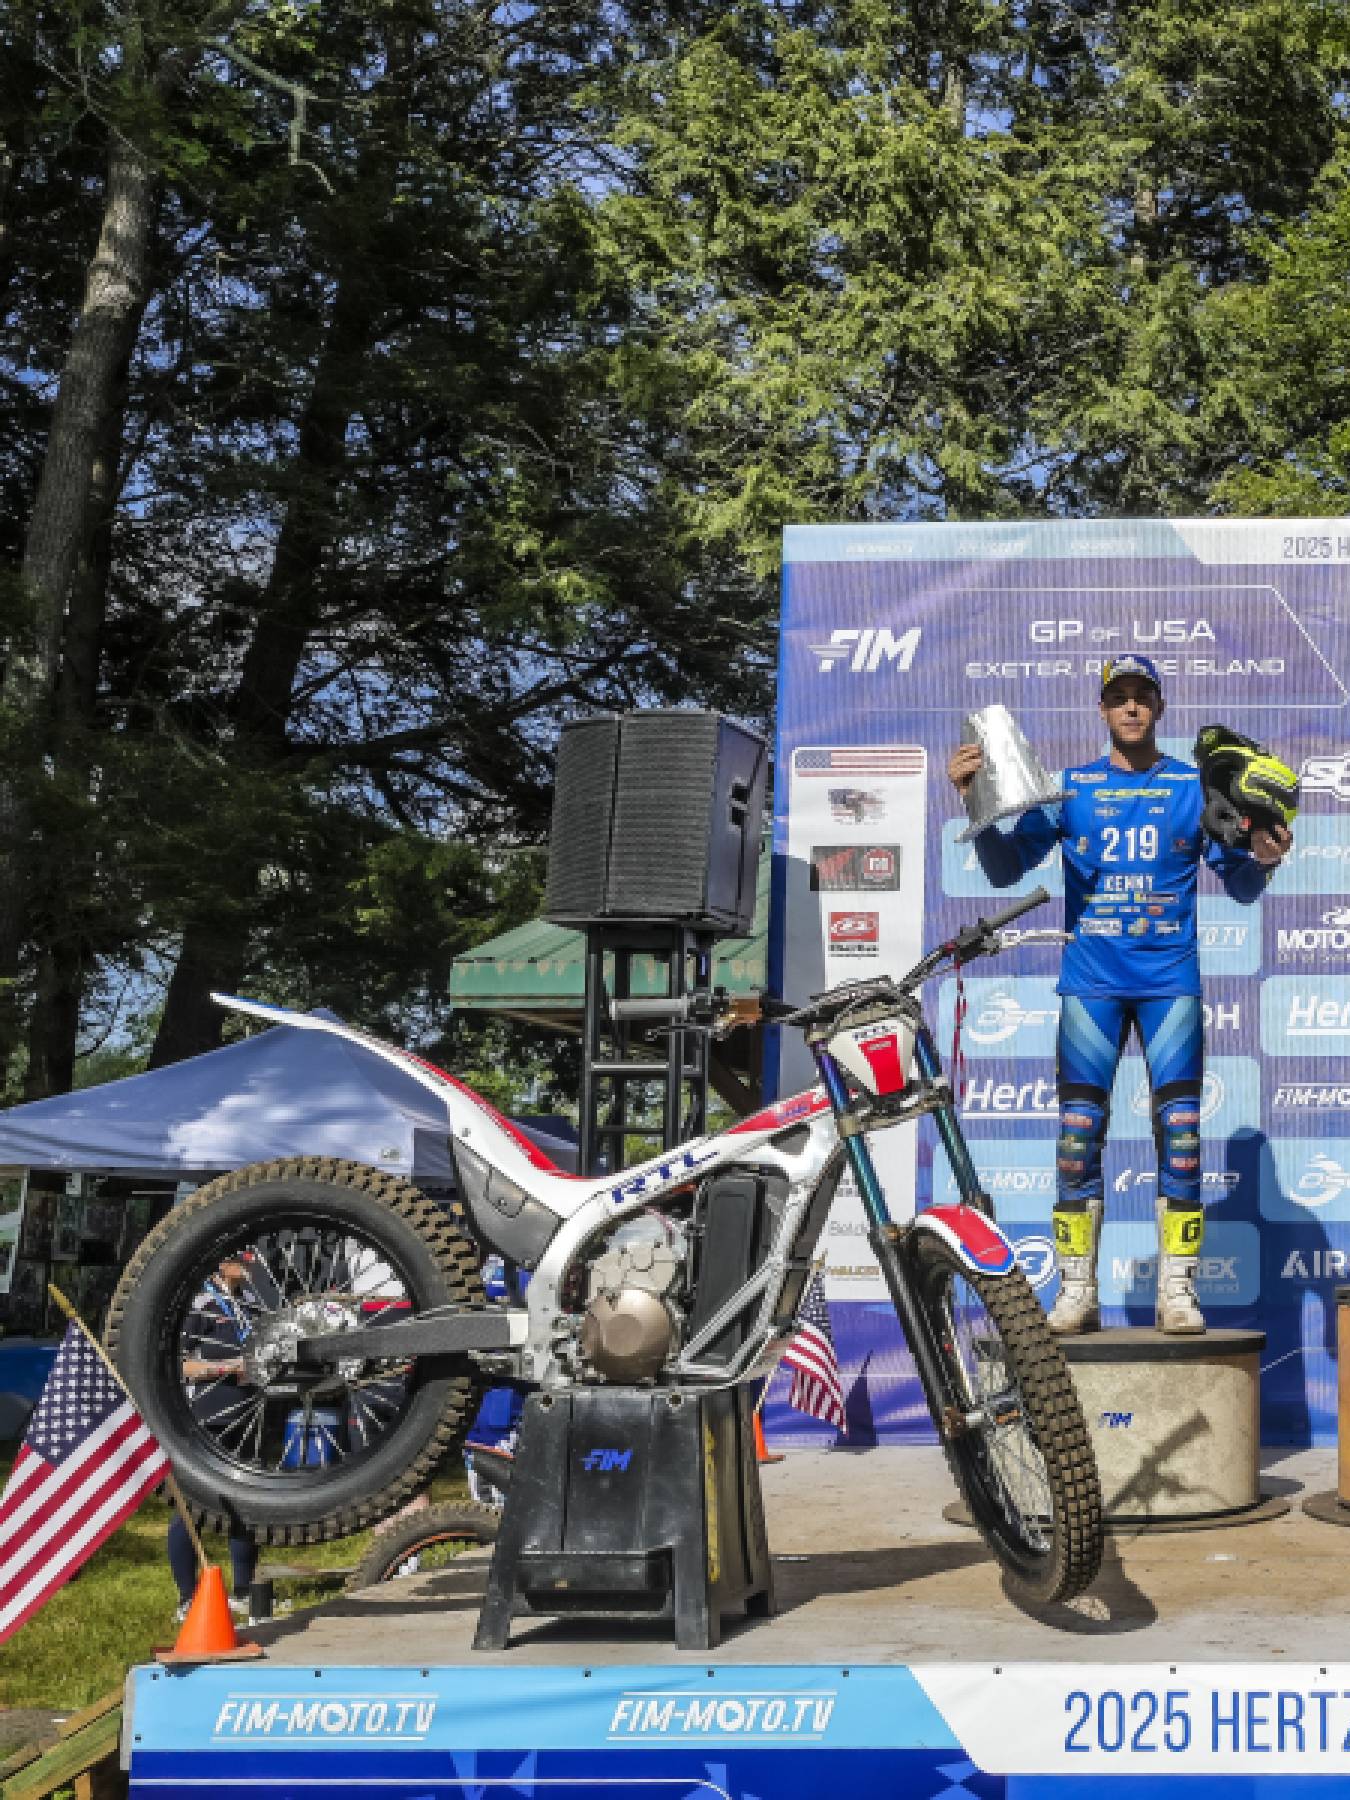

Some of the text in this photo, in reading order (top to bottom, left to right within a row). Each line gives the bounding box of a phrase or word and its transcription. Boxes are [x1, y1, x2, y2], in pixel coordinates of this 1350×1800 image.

[1283, 535, 1333, 559] 2025
[1030, 619, 1083, 643] GP
[1132, 619, 1216, 642] USA
[808, 627, 922, 673] FIM
[1185, 658, 1286, 676] ISLAND
[1100, 825, 1160, 863] 219
[611, 1151, 719, 1204] RTL
[580, 1448, 634, 1472] FIM
[213, 1700, 437, 1734] FIM-MOTO.TV
[608, 1697, 834, 1731] FIM-MOTO.TV
[1063, 1690, 1192, 1753] 2025
